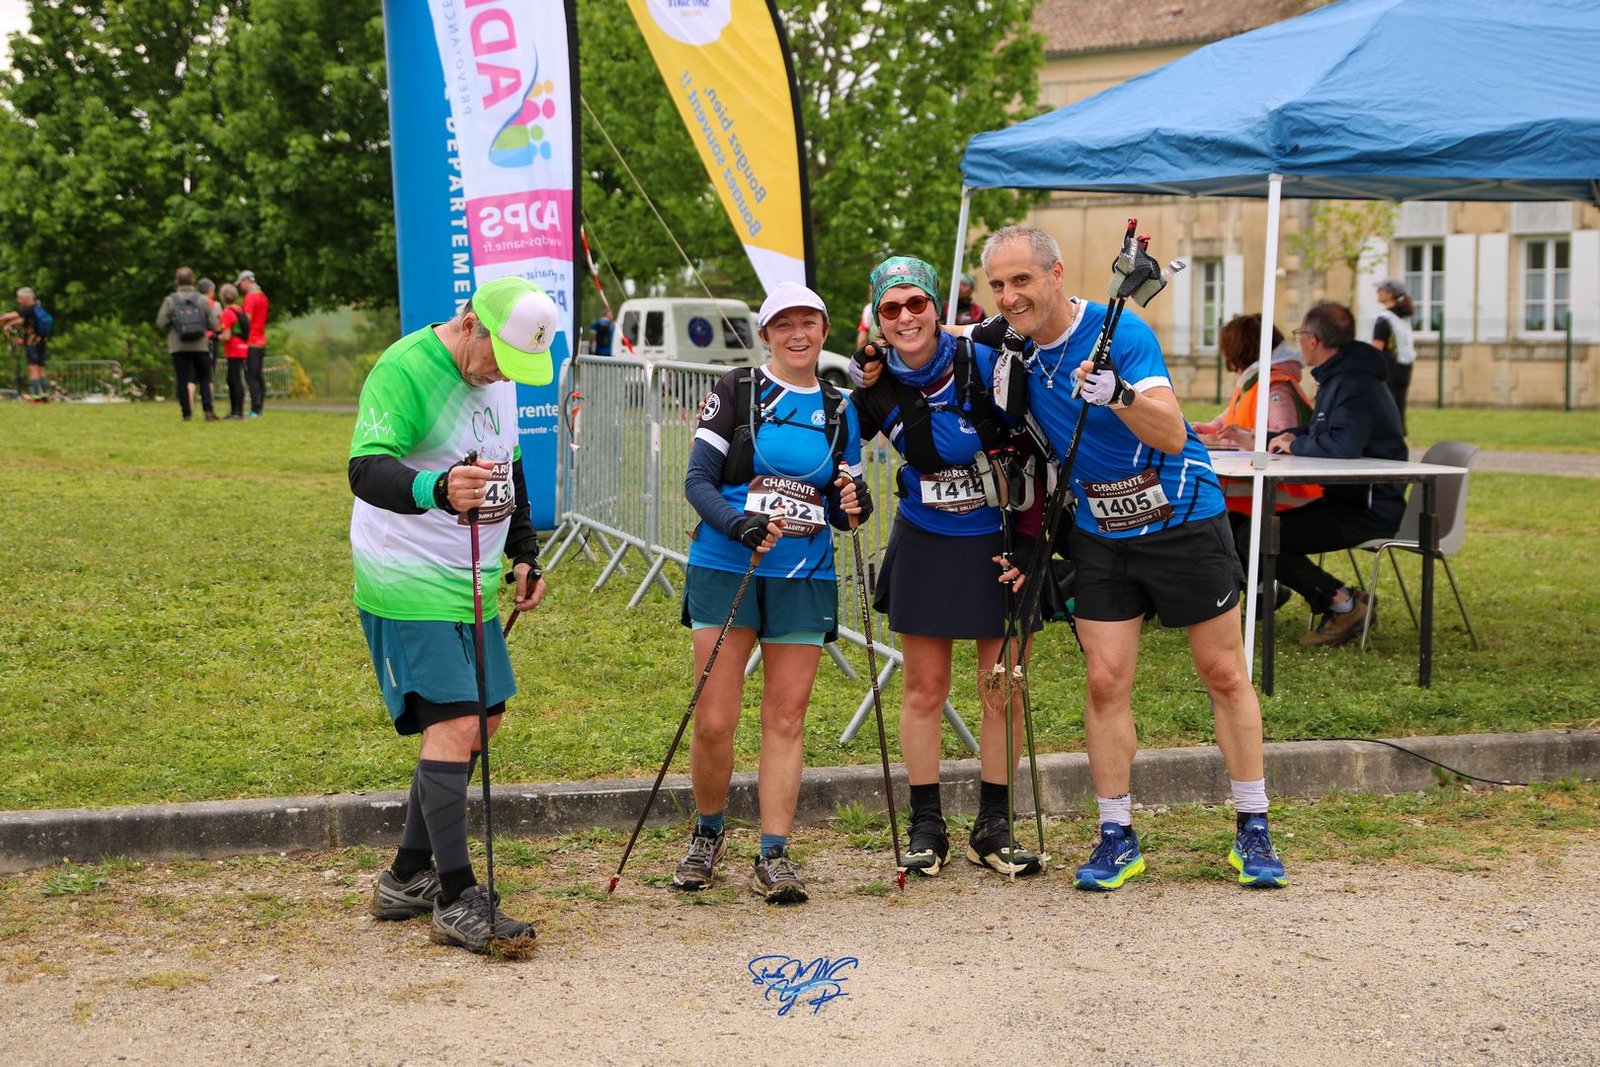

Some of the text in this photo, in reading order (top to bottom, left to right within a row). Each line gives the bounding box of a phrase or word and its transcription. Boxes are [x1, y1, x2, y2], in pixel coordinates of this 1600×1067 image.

[519, 402, 559, 418] rente
[762, 477, 816, 497] CHARENTE
[1092, 475, 1145, 492] CHARENTE
[758, 495, 813, 520] 1432
[1096, 491, 1152, 516] 1405
